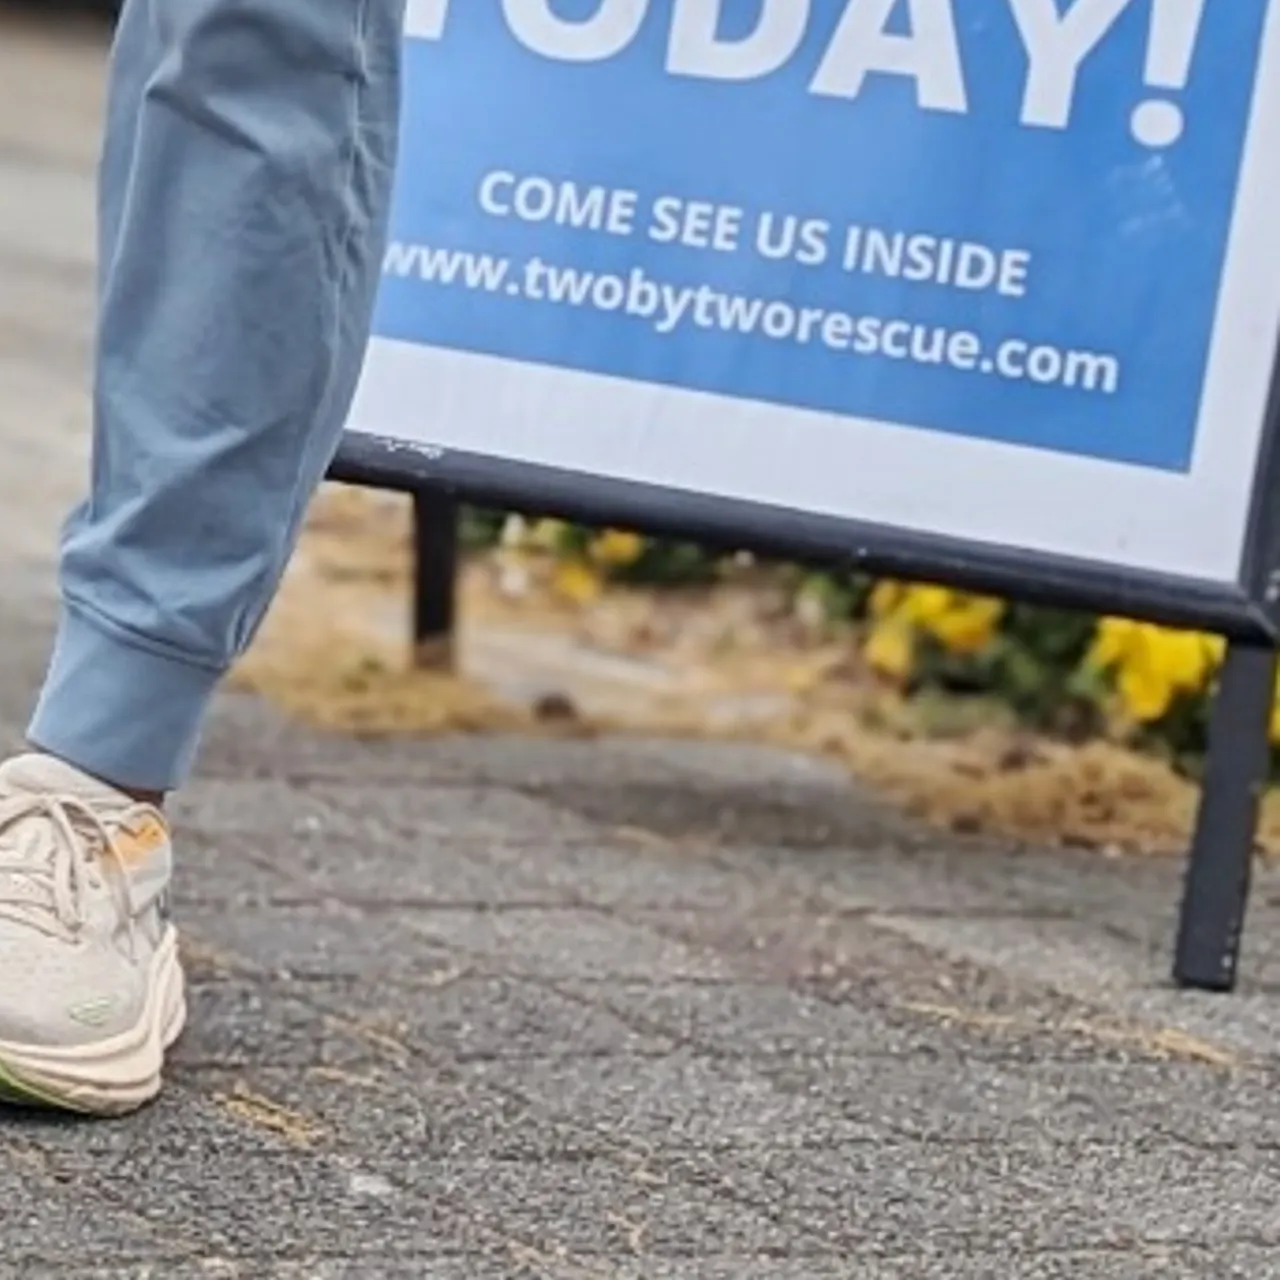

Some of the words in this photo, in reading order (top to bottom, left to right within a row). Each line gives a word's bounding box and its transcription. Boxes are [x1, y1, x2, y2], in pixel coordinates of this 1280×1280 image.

[479, 170, 638, 235] COME
[648, 195, 743, 252] SEE
[755, 211, 831, 266] US
[842, 225, 1032, 298] INSIDE
[383, 240, 1120, 395] www.twobytworescue.com
